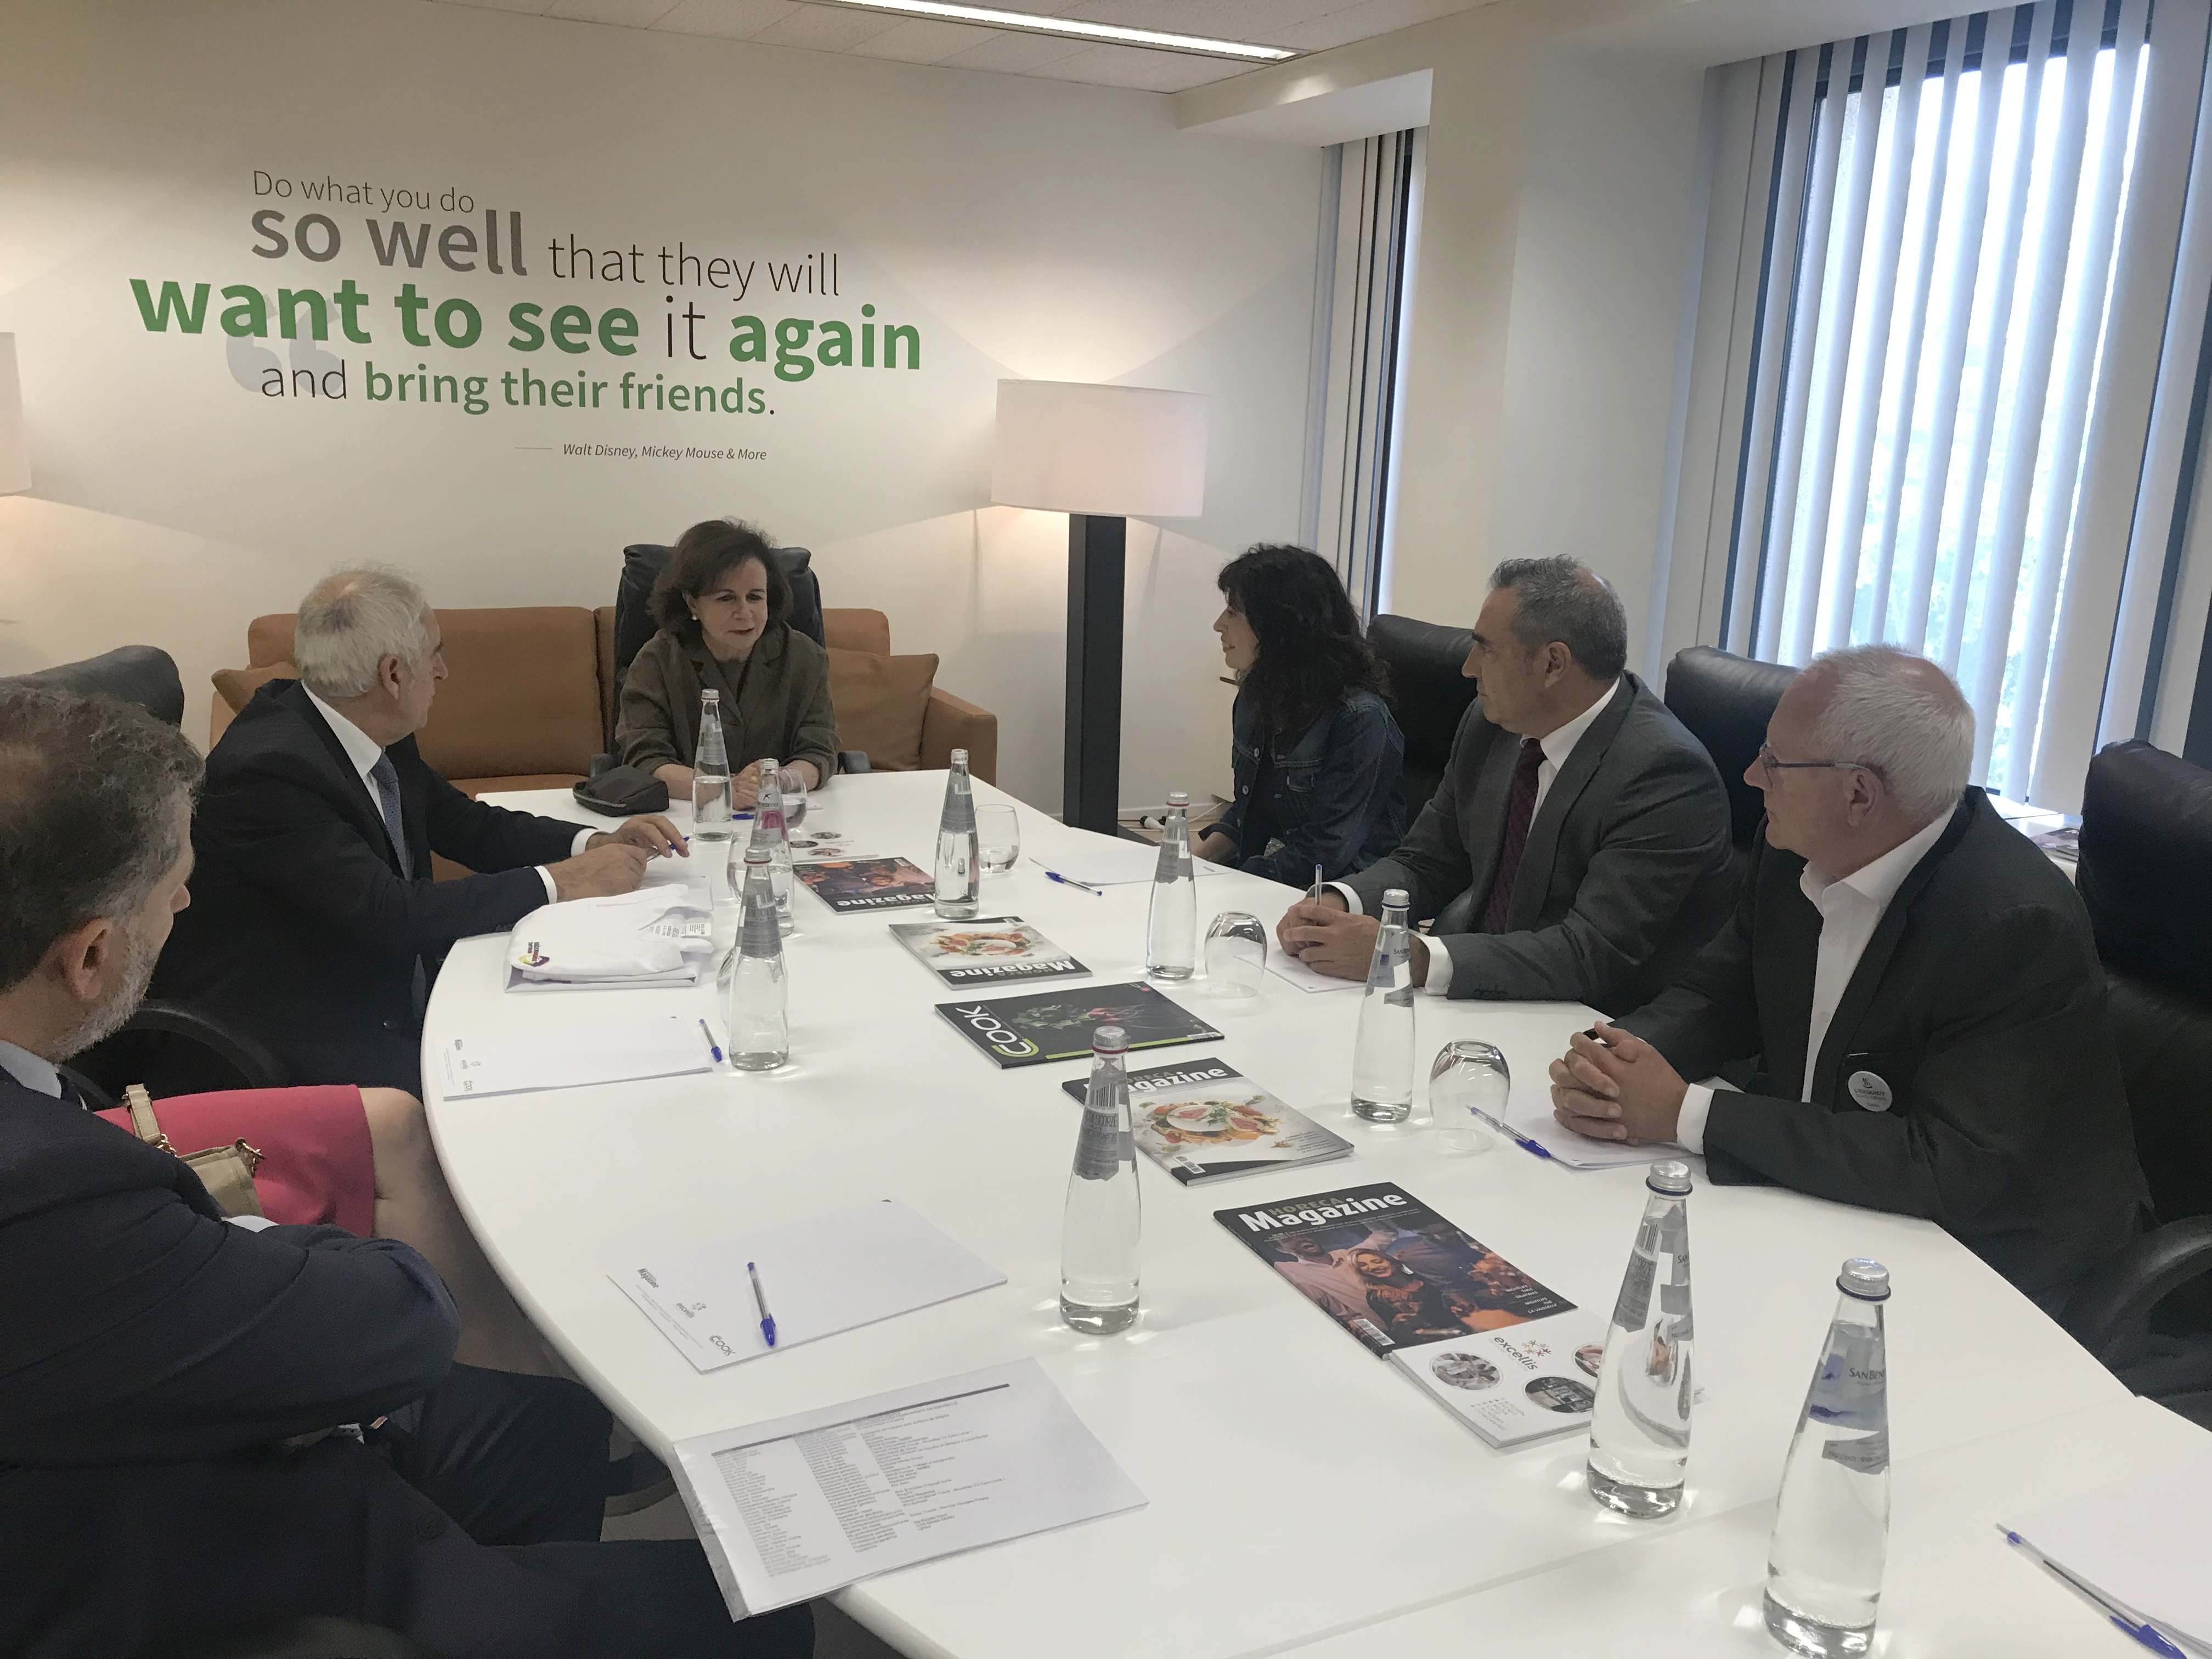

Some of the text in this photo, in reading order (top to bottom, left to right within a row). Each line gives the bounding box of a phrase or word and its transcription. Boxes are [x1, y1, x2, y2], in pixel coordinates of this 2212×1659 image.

[253, 170, 474, 213] Do what you do
[251, 209, 839, 301] so well that they will
[129, 279, 920, 382] want to see it again
[261, 359, 775, 415] and bring their friends.
[563, 444, 767, 460] Walt Disney, Mickey Mouse & More
[950, 961, 1076, 977] Magazine
[955, 1006, 1039, 1057] COOK
[1238, 1194, 1408, 1232] Magazine
[1268, 1197, 1345, 1216] HORECA
[708, 1335, 736, 1356] COOK
[1494, 1337, 1538, 1370] excellis
